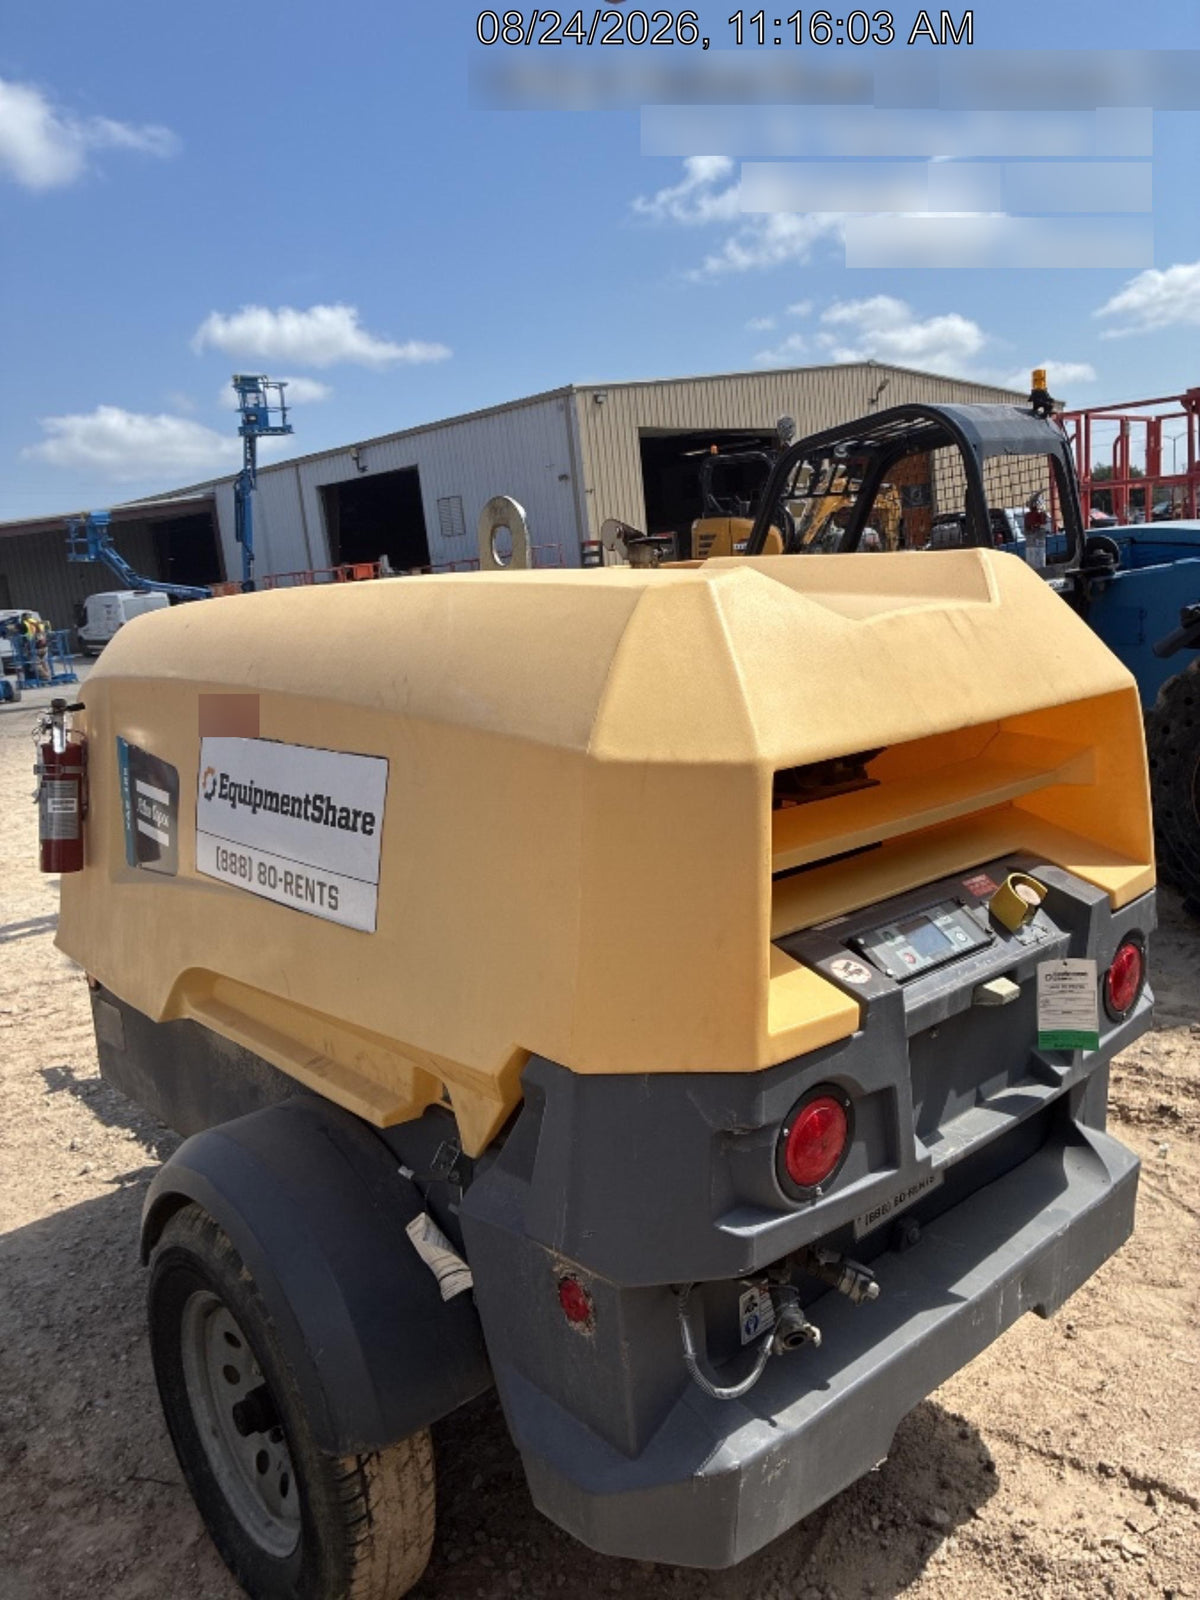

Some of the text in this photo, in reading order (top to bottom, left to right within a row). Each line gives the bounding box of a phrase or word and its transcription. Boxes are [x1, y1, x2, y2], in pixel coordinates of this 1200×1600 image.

[218, 773, 376, 836] EquipmentShare
[216, 846, 339, 911] (888) 80-RENTS
